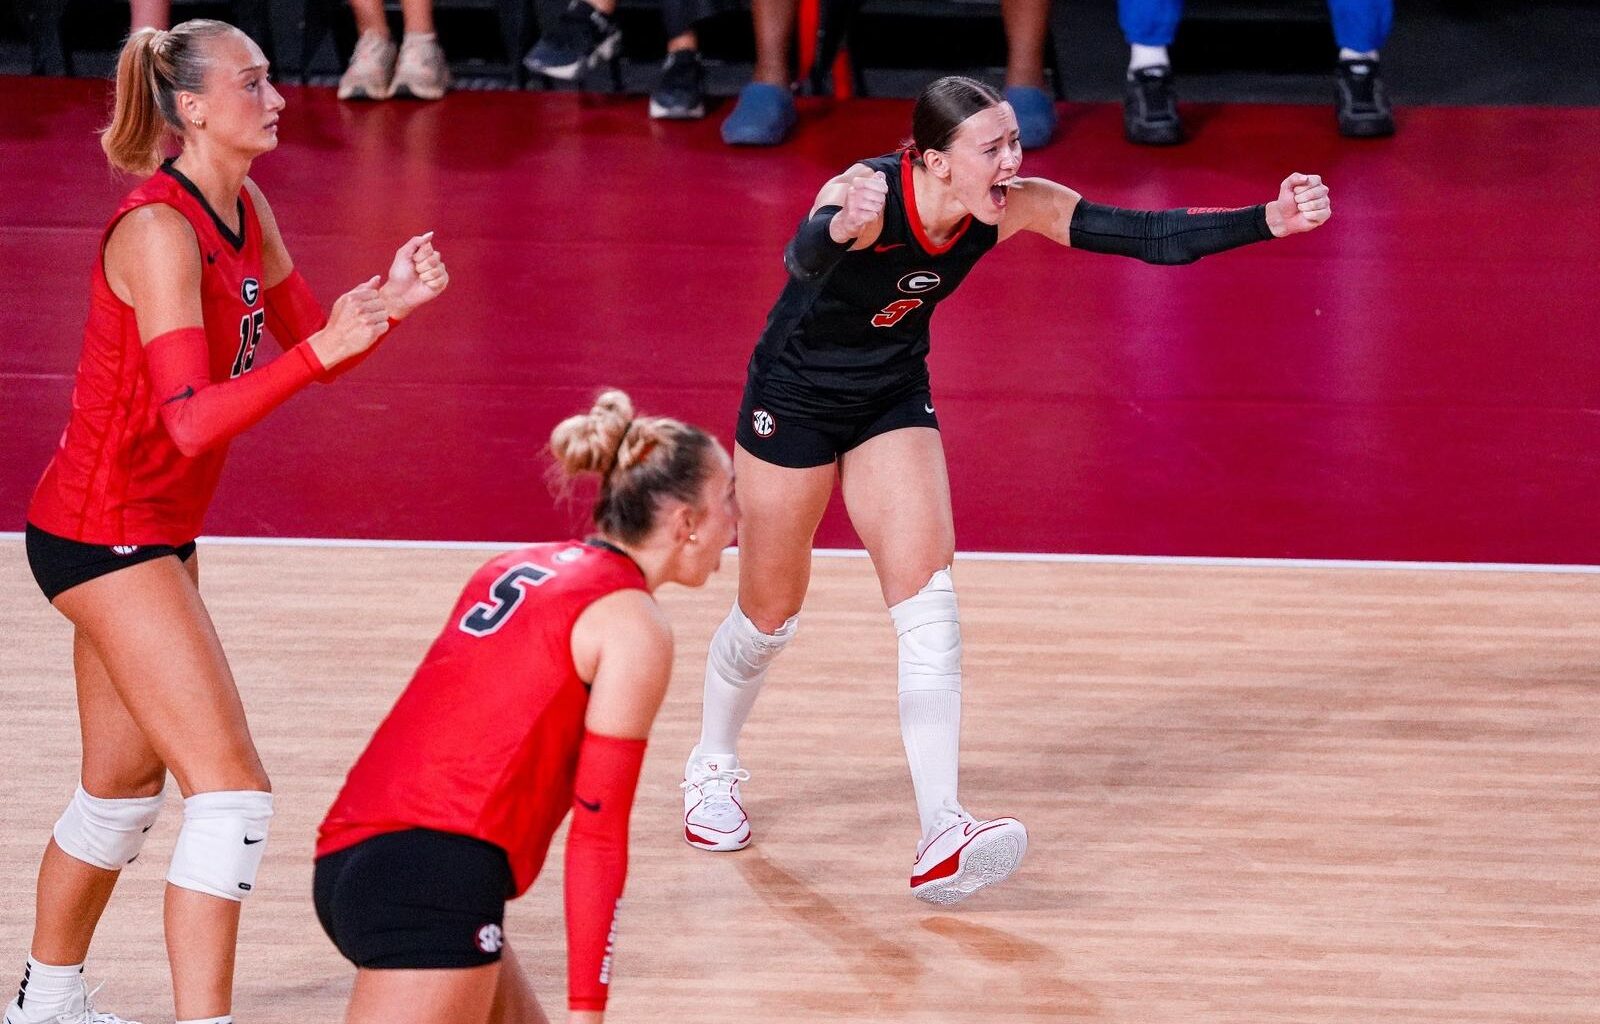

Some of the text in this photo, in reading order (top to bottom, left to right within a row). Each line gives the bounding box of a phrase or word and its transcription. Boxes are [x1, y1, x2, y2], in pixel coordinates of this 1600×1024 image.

[242, 280, 259, 304] G
[904, 274, 940, 291] G
[871, 299, 923, 327] 9
[230, 308, 264, 379] 15
[753, 410, 774, 436] SEC
[459, 562, 557, 637] 5
